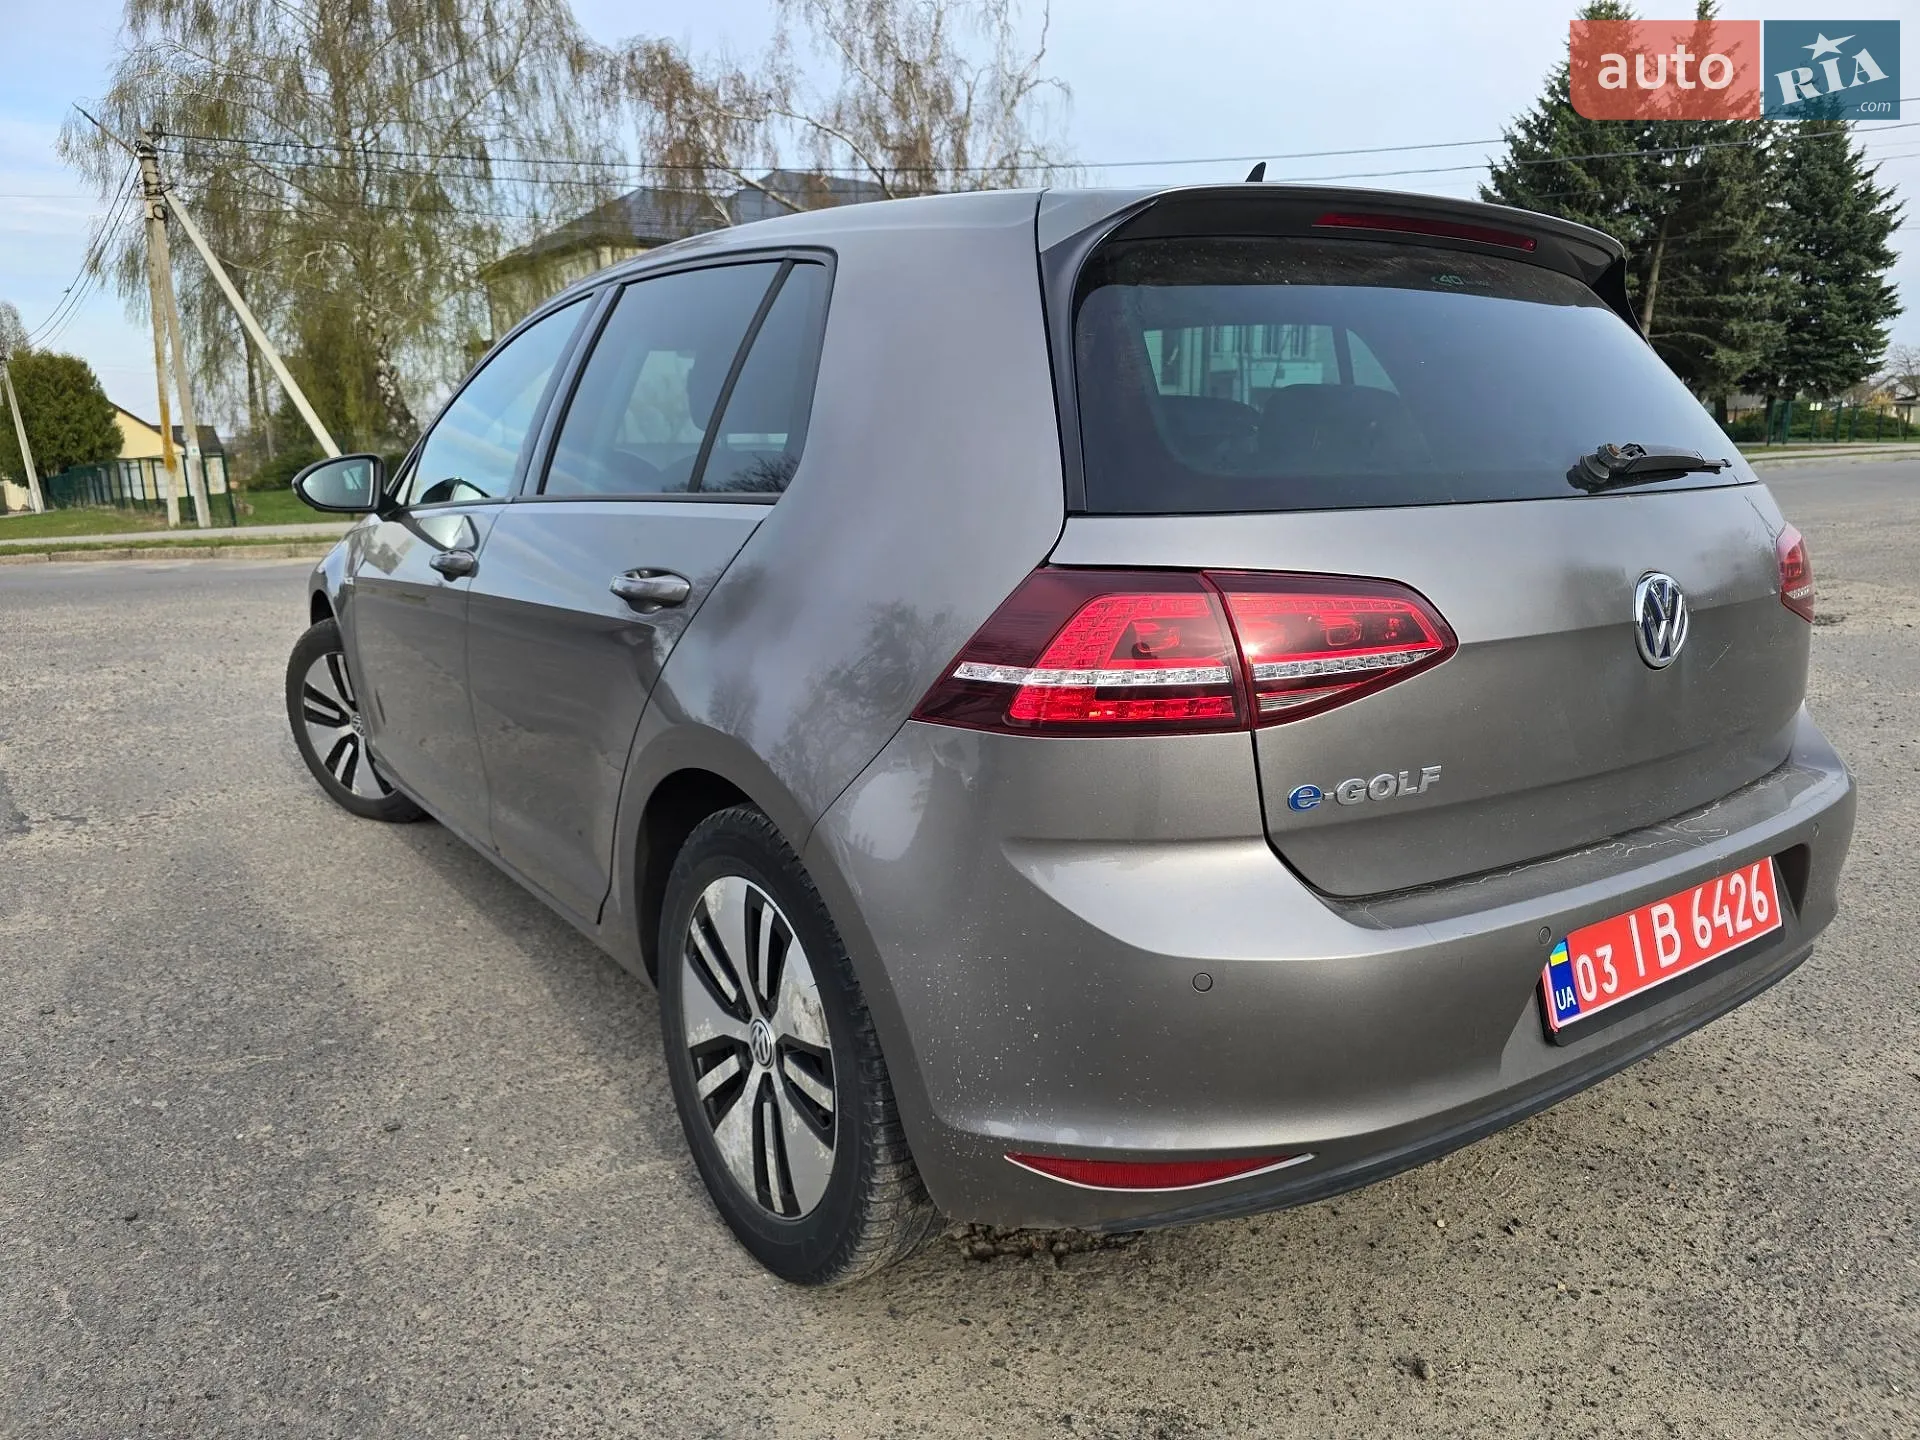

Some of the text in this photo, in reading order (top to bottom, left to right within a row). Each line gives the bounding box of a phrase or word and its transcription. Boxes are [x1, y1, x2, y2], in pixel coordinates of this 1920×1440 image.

[1287, 765, 1443, 812] e-GOLF
[1575, 943, 1619, 1003] 03
[1691, 863, 1770, 949] 6426
[1555, 986, 1577, 1011] UA
